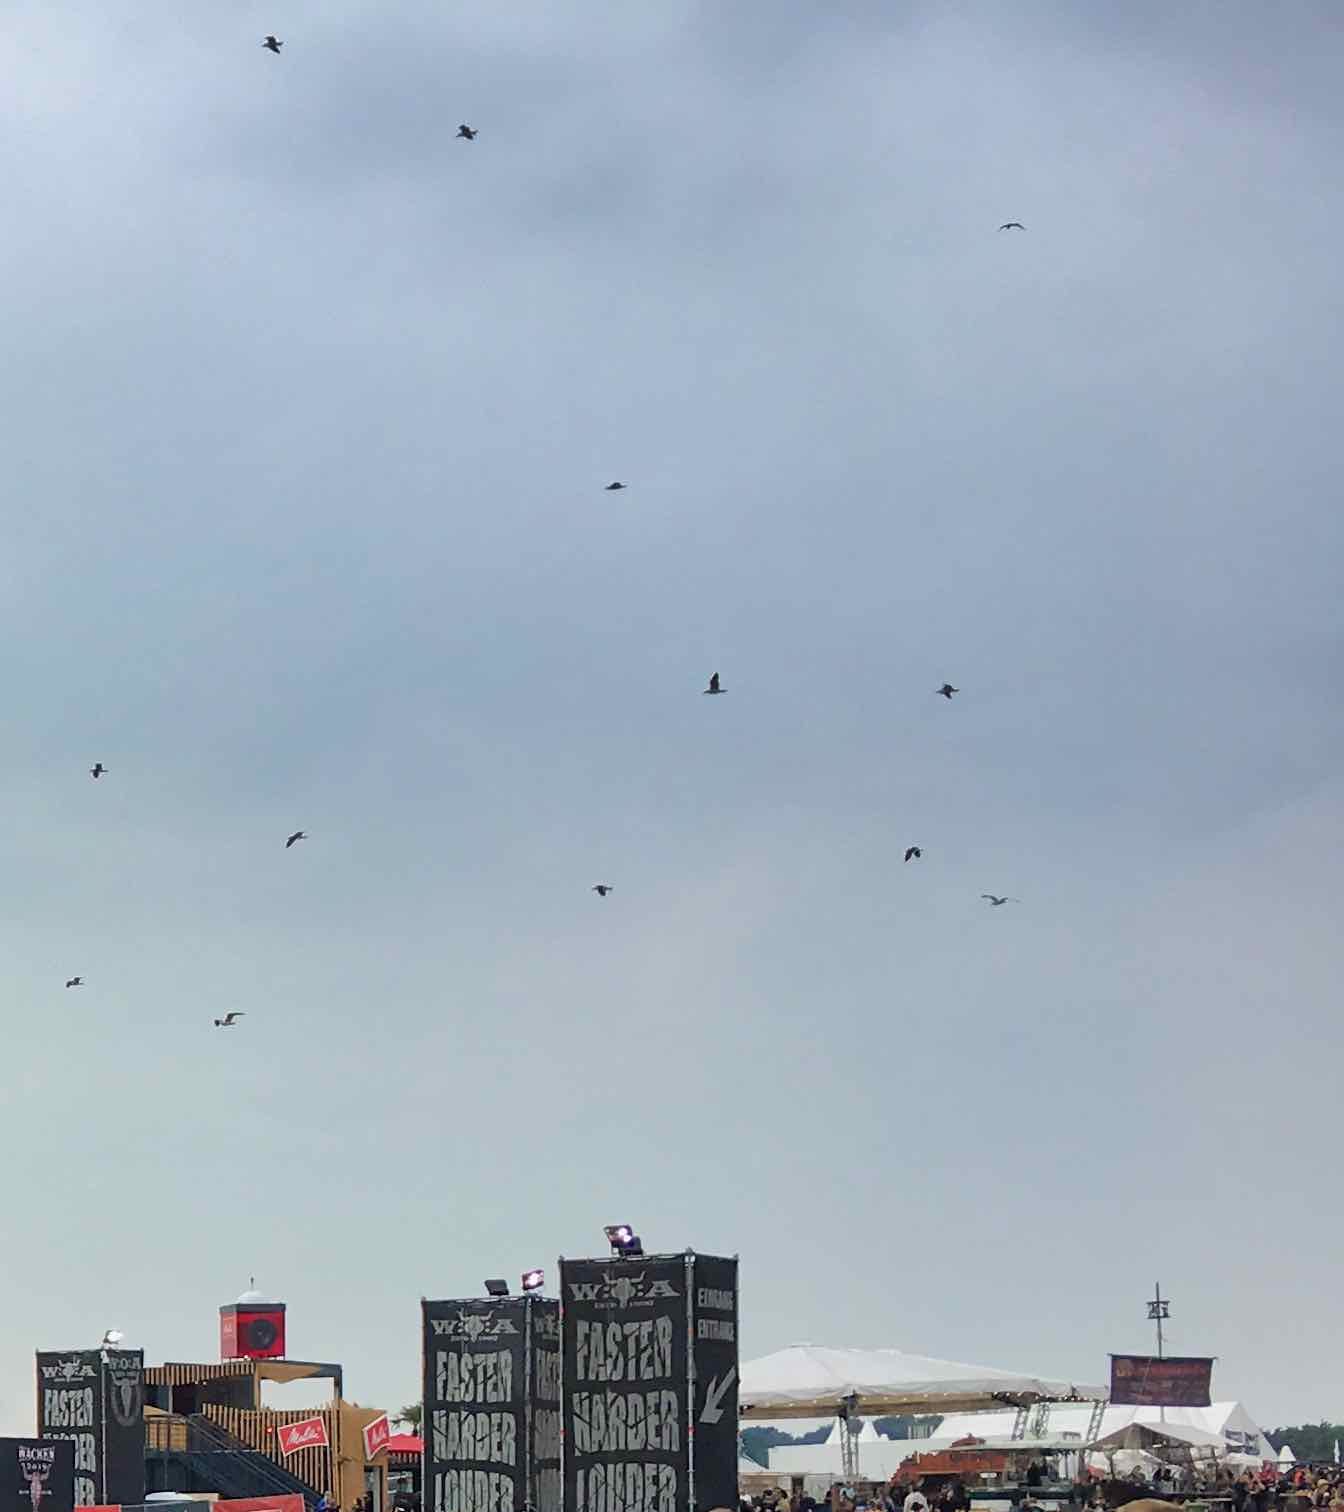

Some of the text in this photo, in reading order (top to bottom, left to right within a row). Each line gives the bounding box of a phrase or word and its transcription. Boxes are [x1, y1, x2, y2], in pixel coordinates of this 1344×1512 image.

[577, 1315, 672, 1381] FASTER
[436, 1350, 512, 1402] FASTER
[45, 1387, 93, 1427] FASTER
[573, 1390, 680, 1456] HARDER
[18, 1446, 55, 1461] WACKEN
[433, 1410, 516, 1466] HARDER
